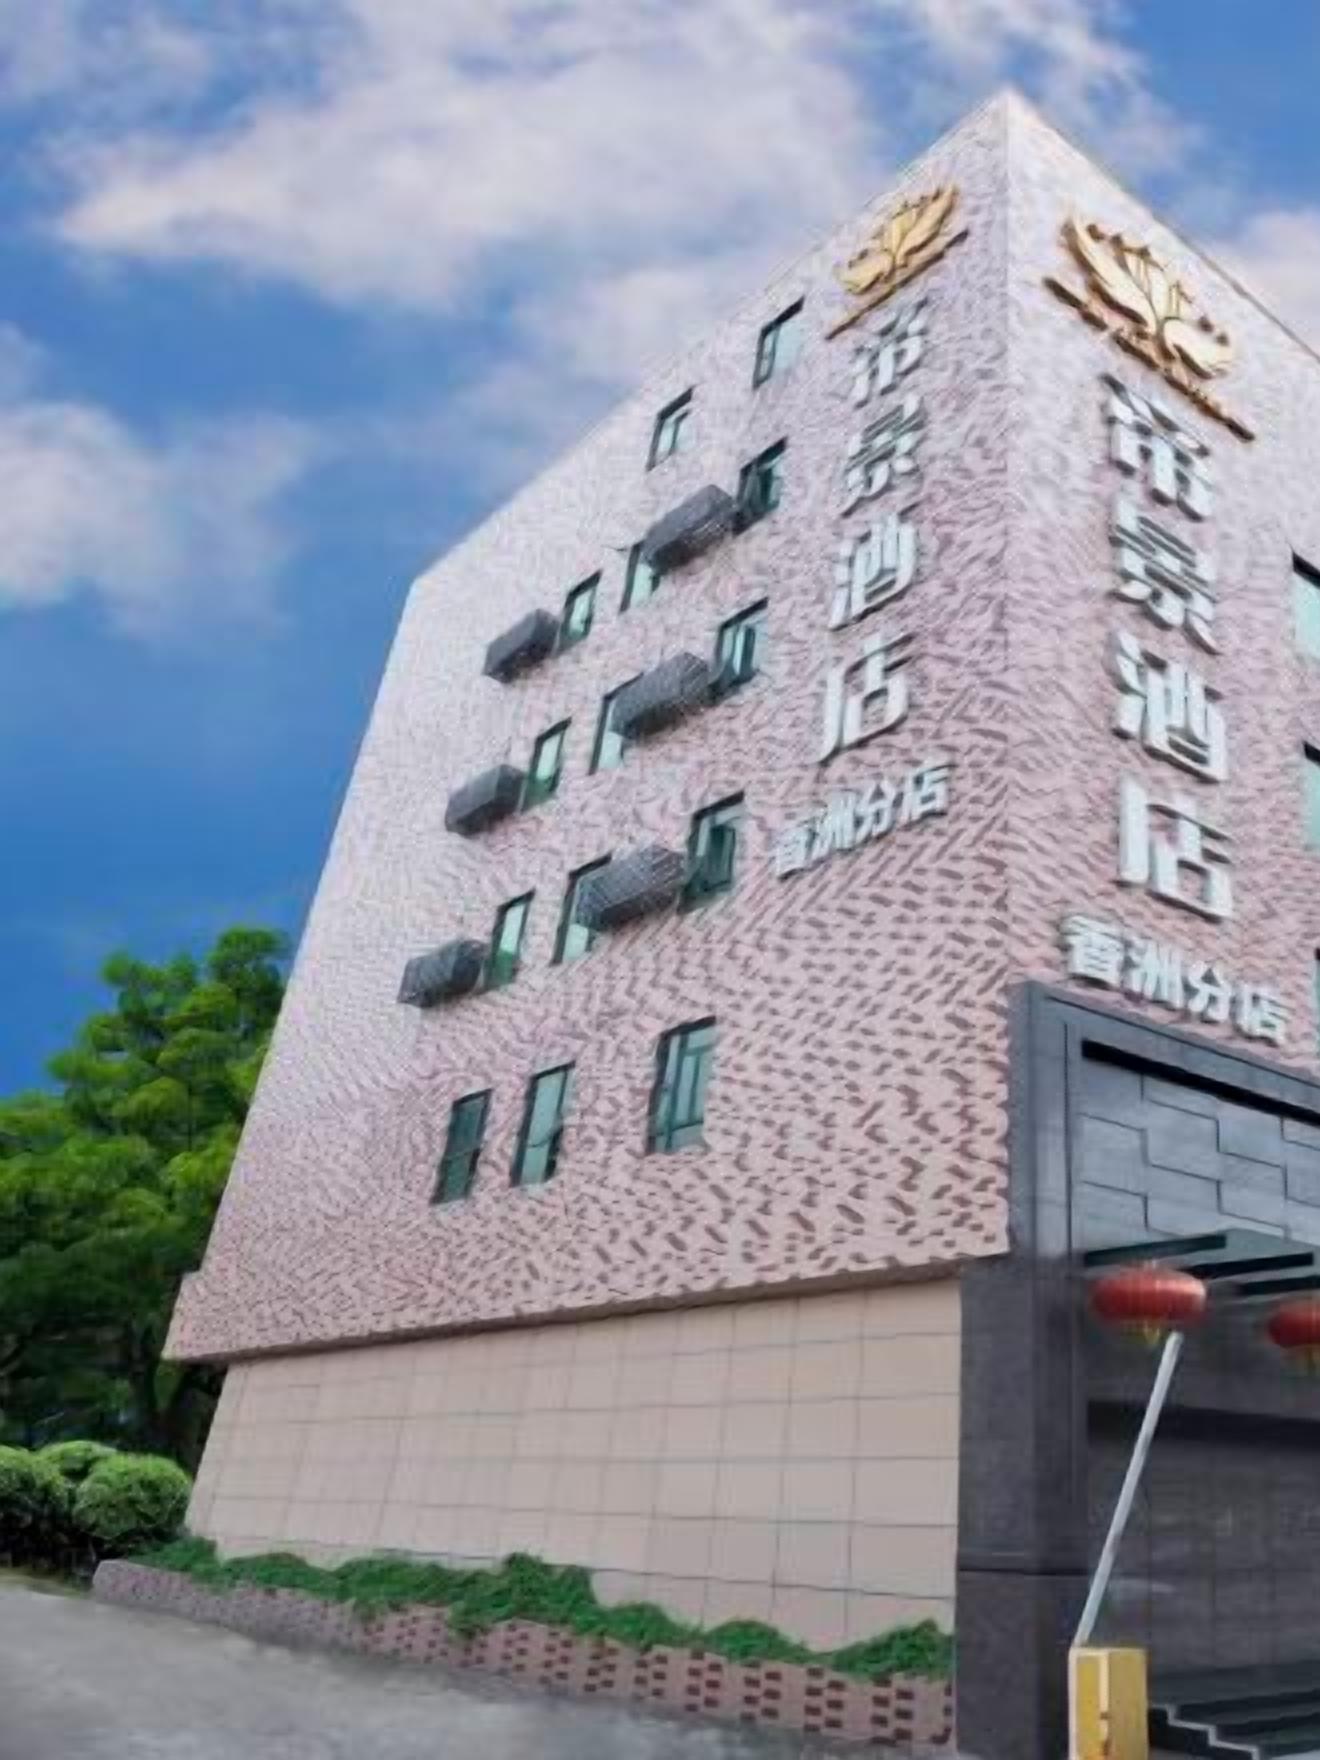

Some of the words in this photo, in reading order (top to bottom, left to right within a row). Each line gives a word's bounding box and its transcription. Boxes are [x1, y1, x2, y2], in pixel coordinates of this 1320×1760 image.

[816, 298, 928, 763] 帝景酒店
[1103, 374, 1232, 921] 帝景酒店
[768, 757, 955, 878] 香洲分店
[1066, 915, 1290, 1042] 香洲分店
